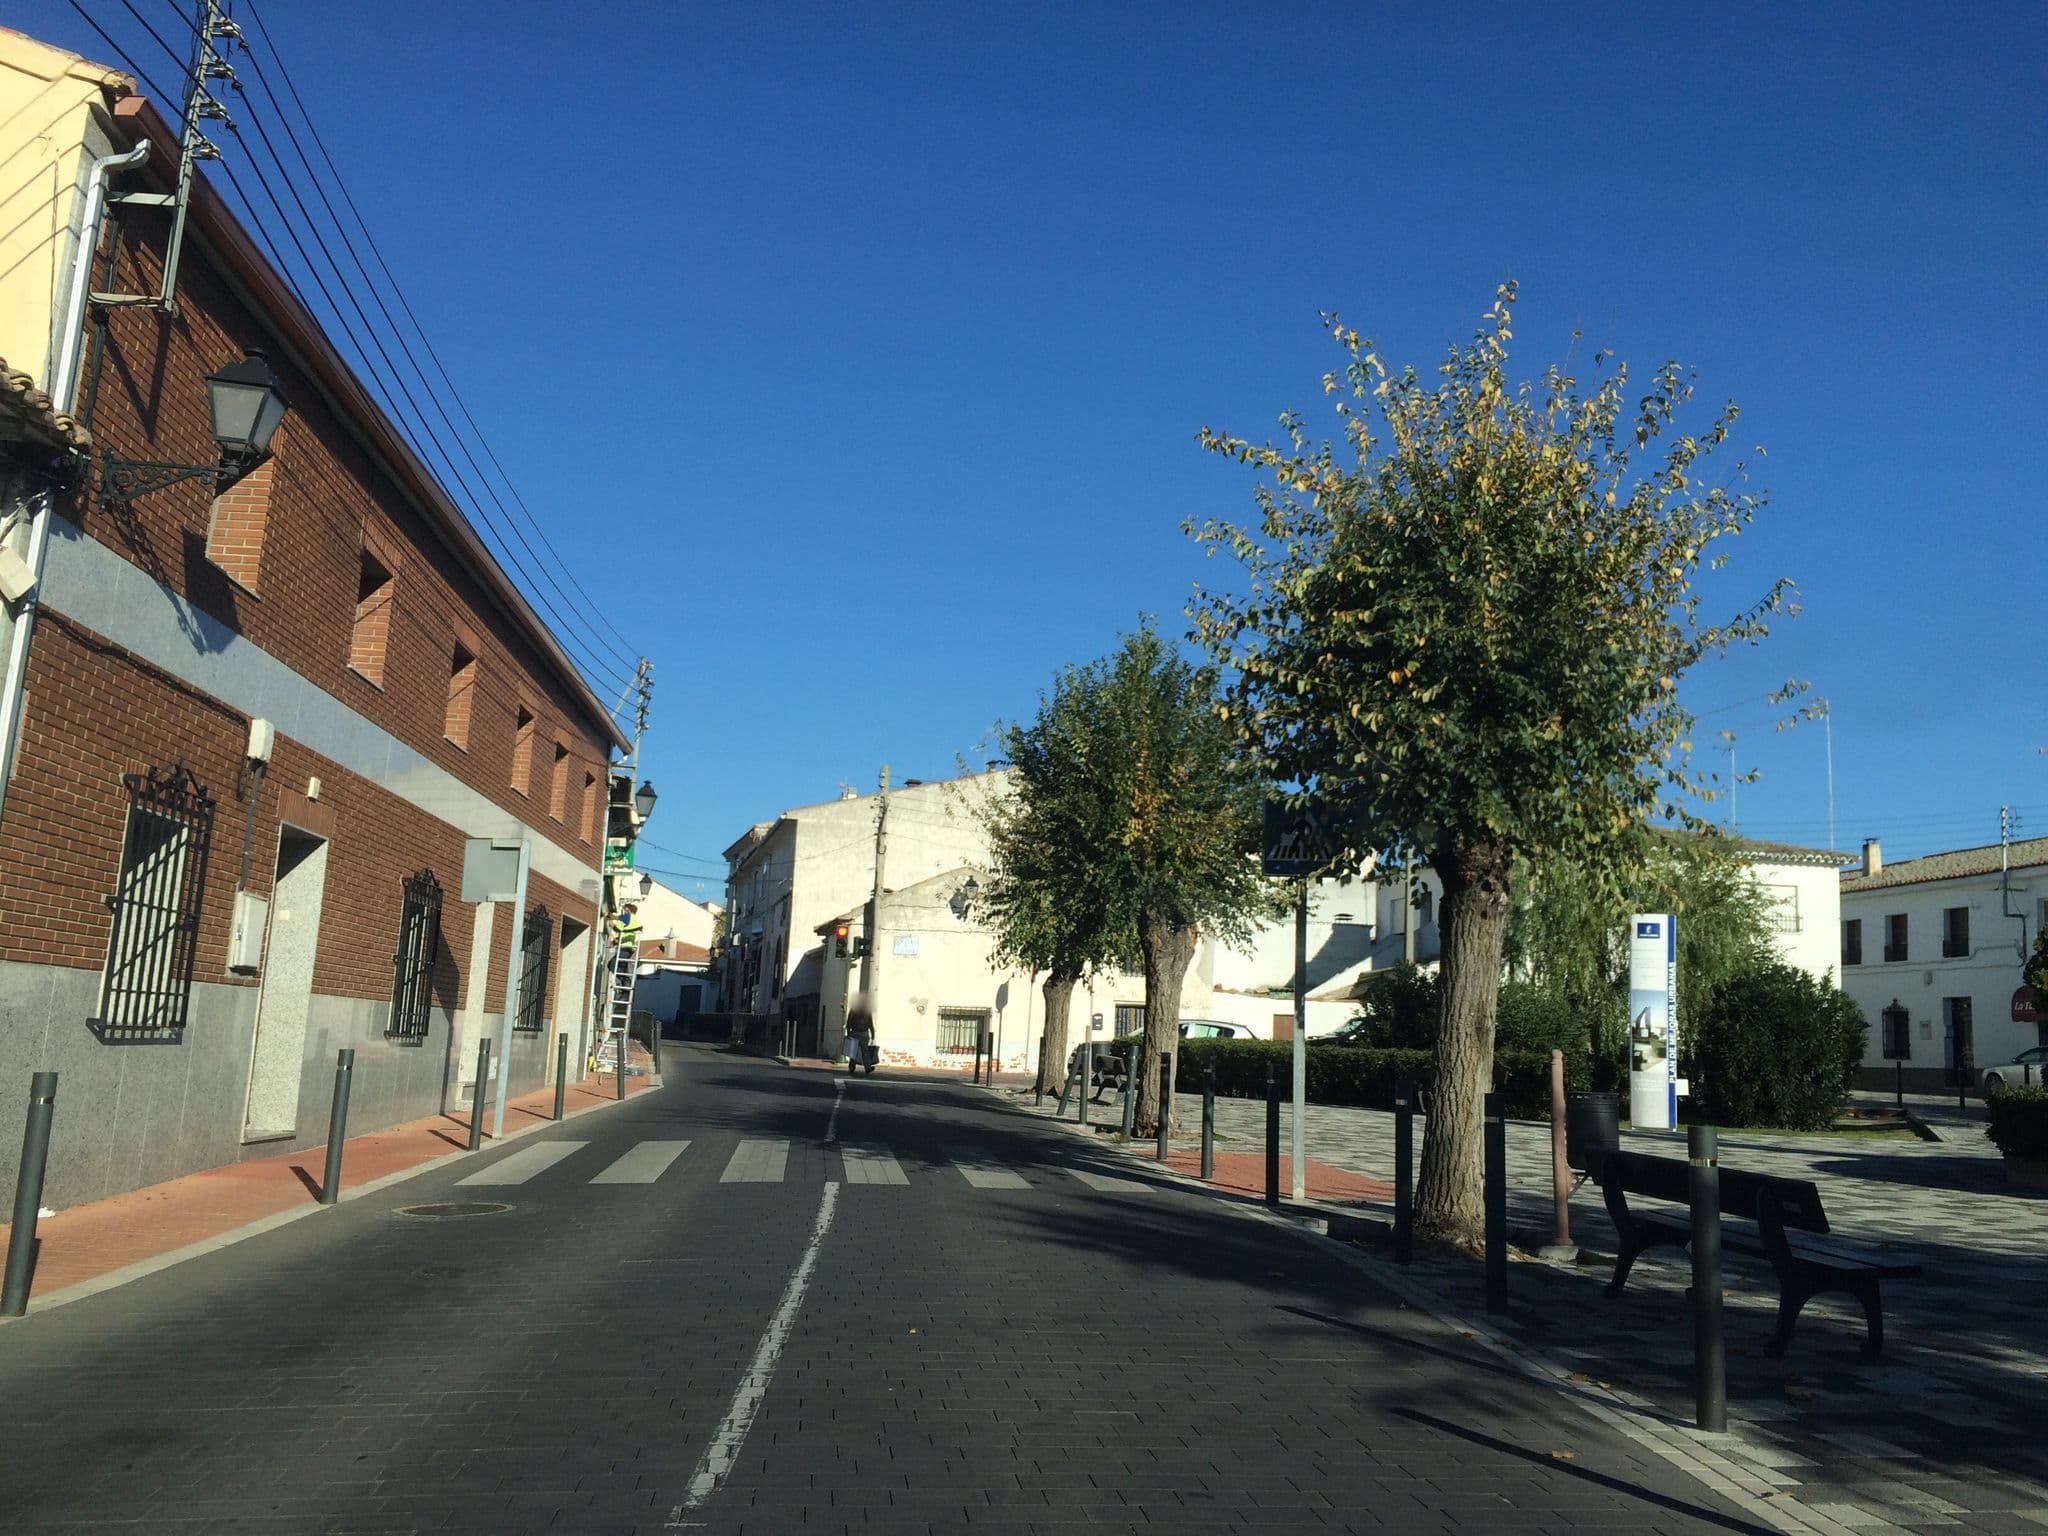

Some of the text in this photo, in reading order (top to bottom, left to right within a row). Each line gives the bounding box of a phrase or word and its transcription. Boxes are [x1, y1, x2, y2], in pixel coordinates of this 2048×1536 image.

[1668, 962, 1676, 1083] PLAN DE MEJORAS URBANAS
